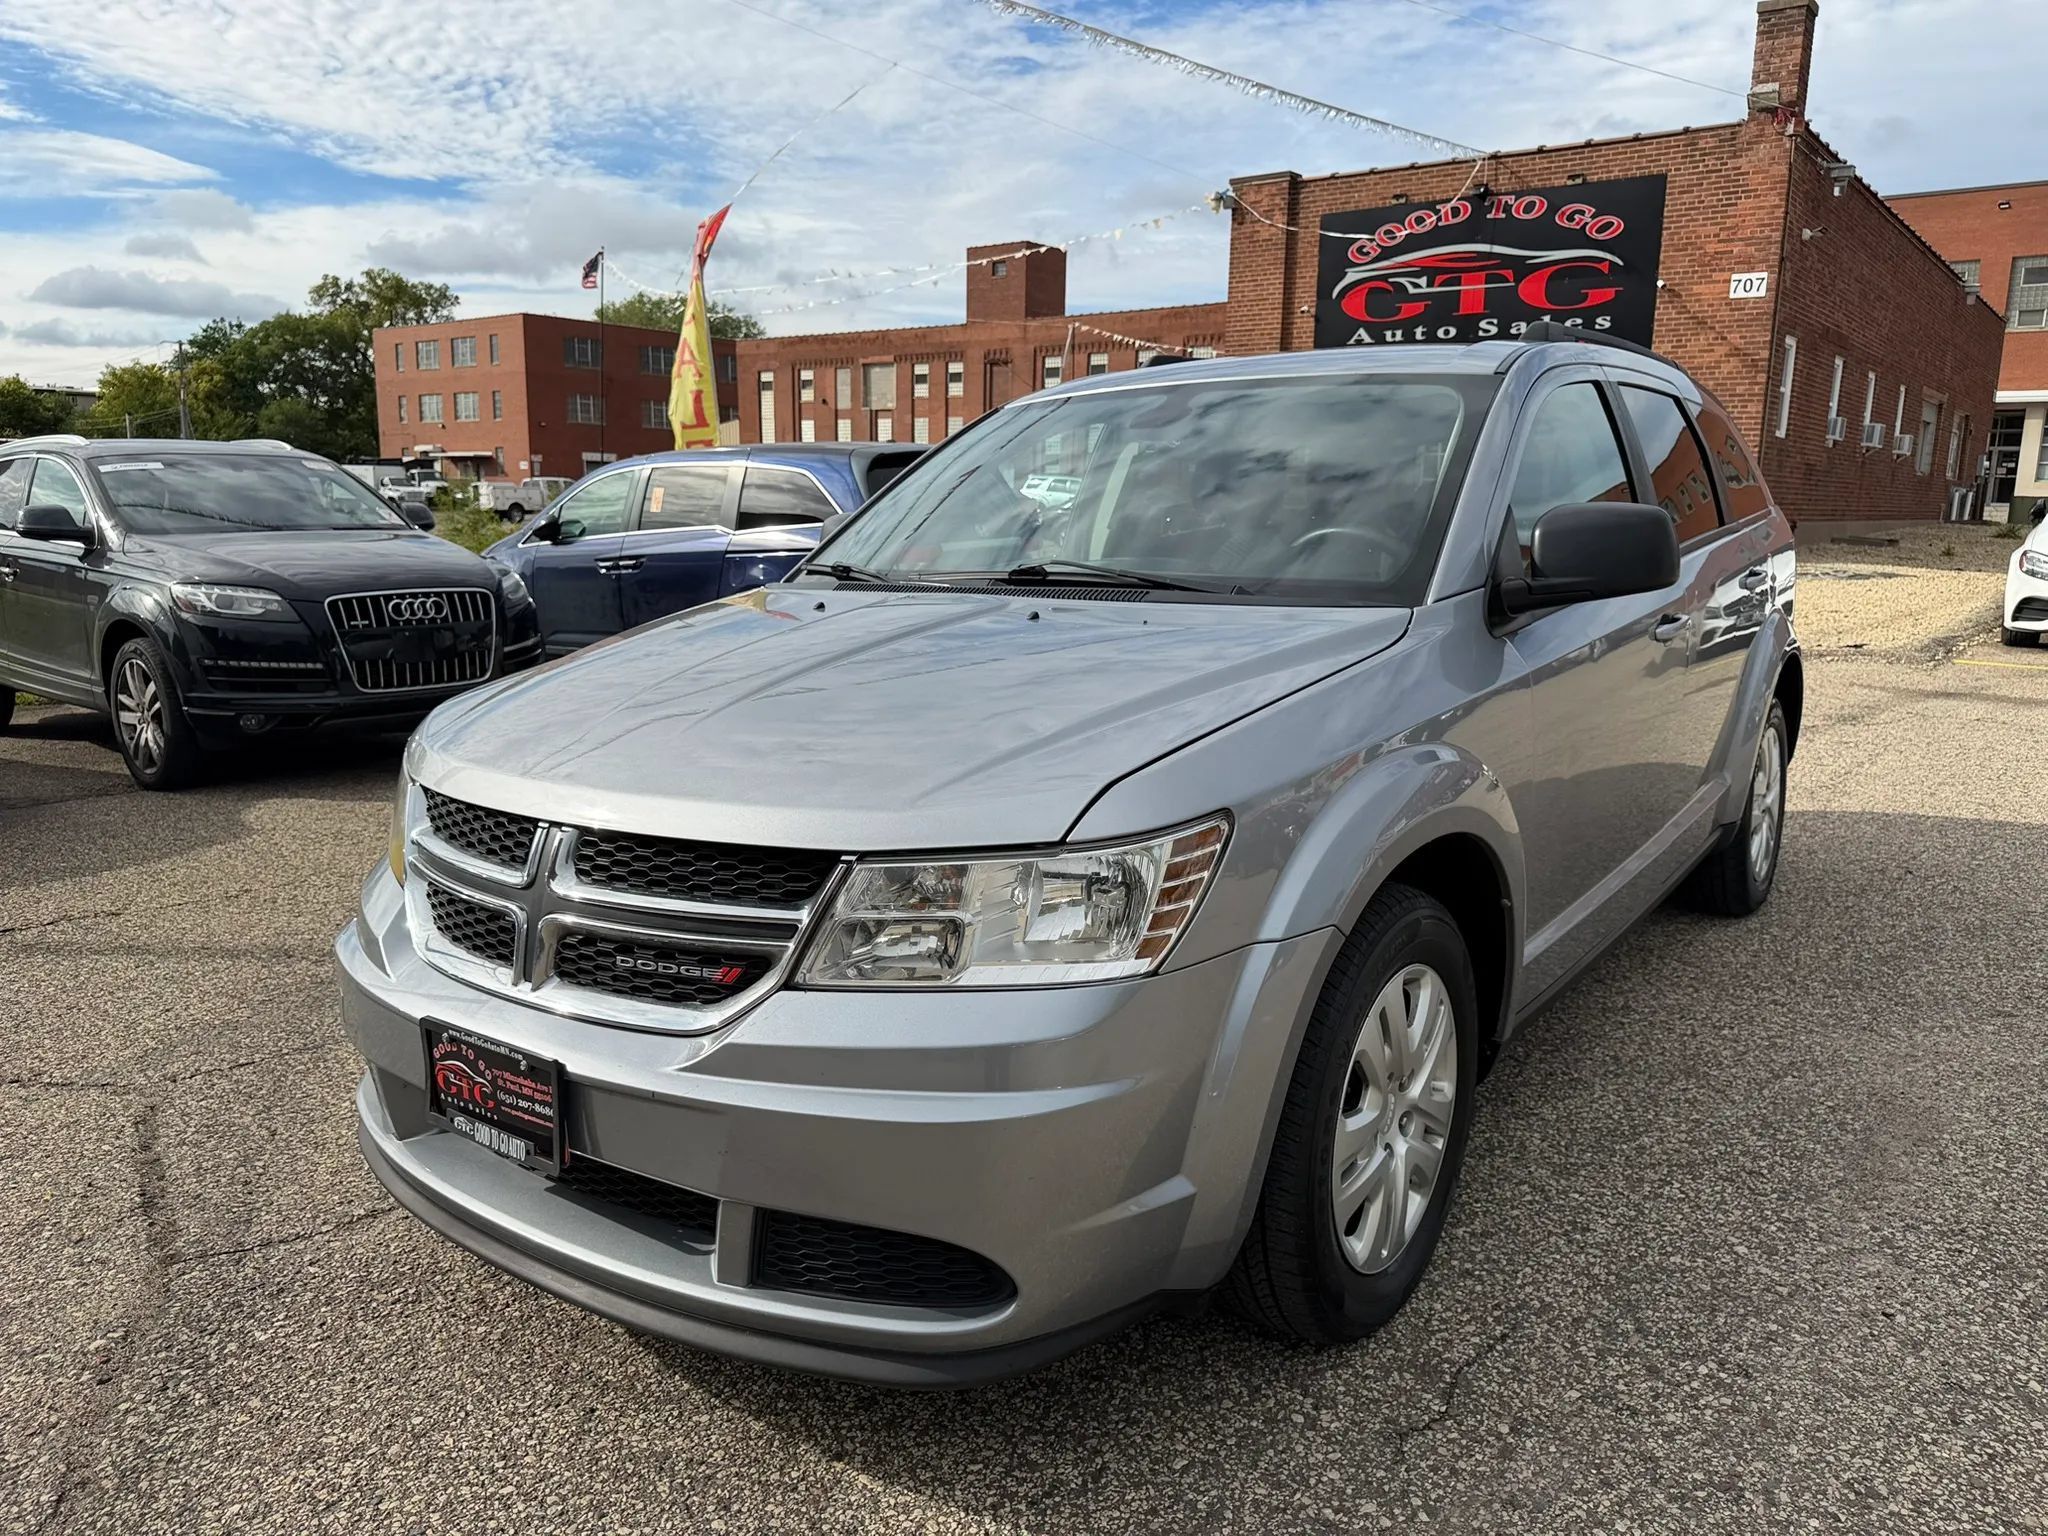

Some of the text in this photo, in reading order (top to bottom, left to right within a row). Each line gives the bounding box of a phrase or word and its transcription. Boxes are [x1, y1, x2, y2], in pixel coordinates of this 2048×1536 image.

[1348, 195, 1625, 264] GOOD TO GO
[1340, 261, 1624, 322] GTG
[1732, 277, 1766, 294] 707
[1346, 325, 1458, 345] Auto
[616, 956, 723, 979] DODGE
[432, 1041, 458, 1059] GOOD
[460, 1044, 475, 1060] TO
[435, 1070, 496, 1108] GTG
[497, 1089, 517, 1106] (651)
[474, 1121, 526, 1162] GOOD TO GO AUTO
